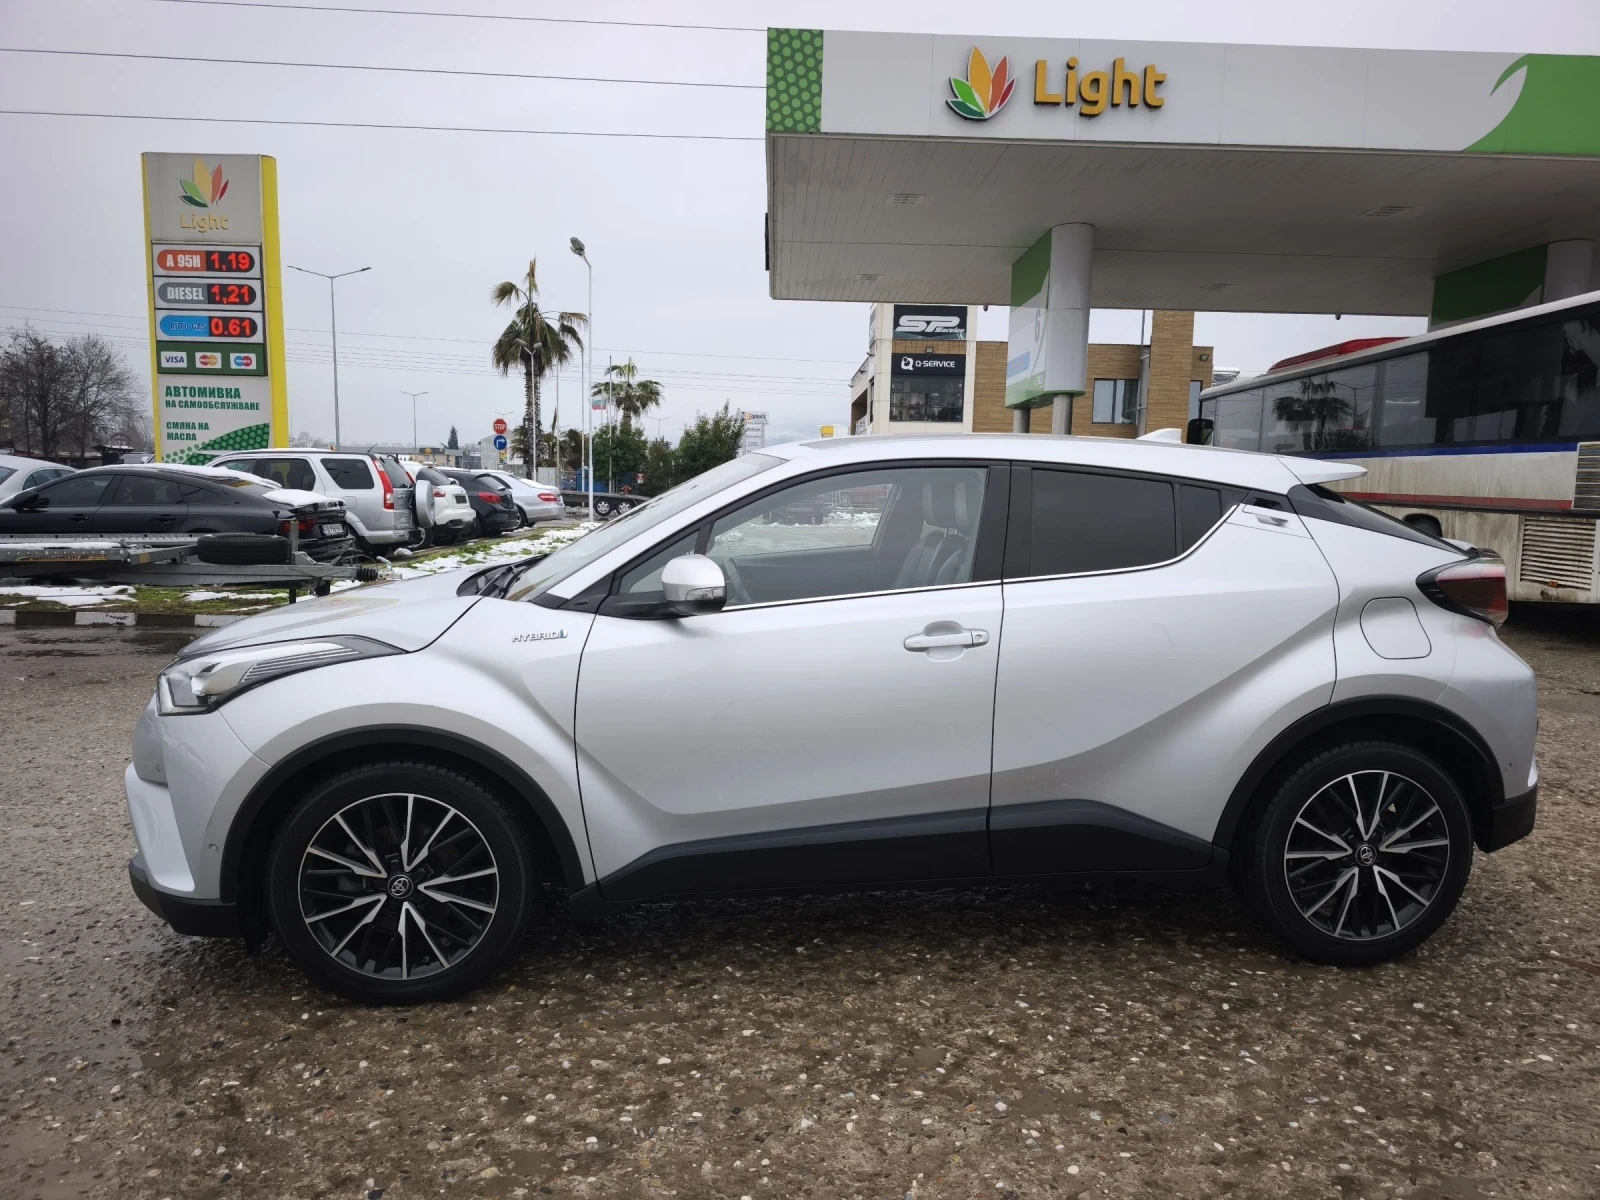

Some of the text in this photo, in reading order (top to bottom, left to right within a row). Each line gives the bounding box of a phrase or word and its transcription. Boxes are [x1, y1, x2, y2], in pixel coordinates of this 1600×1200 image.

[1034, 56, 1167, 117] Light
[180, 212, 229, 233] Light
[166, 254, 174, 267] A
[177, 254, 201, 268] 95H
[167, 287, 204, 300] DIESEL
[191, 322, 207, 332] GAS
[210, 317, 251, 336] 0.61
[894, 315, 960, 333] SP
[164, 355, 185, 363] VISA
[165, 385, 241, 399] АВТОМИВКА
[165, 400, 260, 411] НА САМООБСЛУЖВАНЕ
[166, 421, 210, 431] СМЯНА НА
[166, 432, 197, 441] МАСЛА
[512, 631, 560, 643] HYBRID
